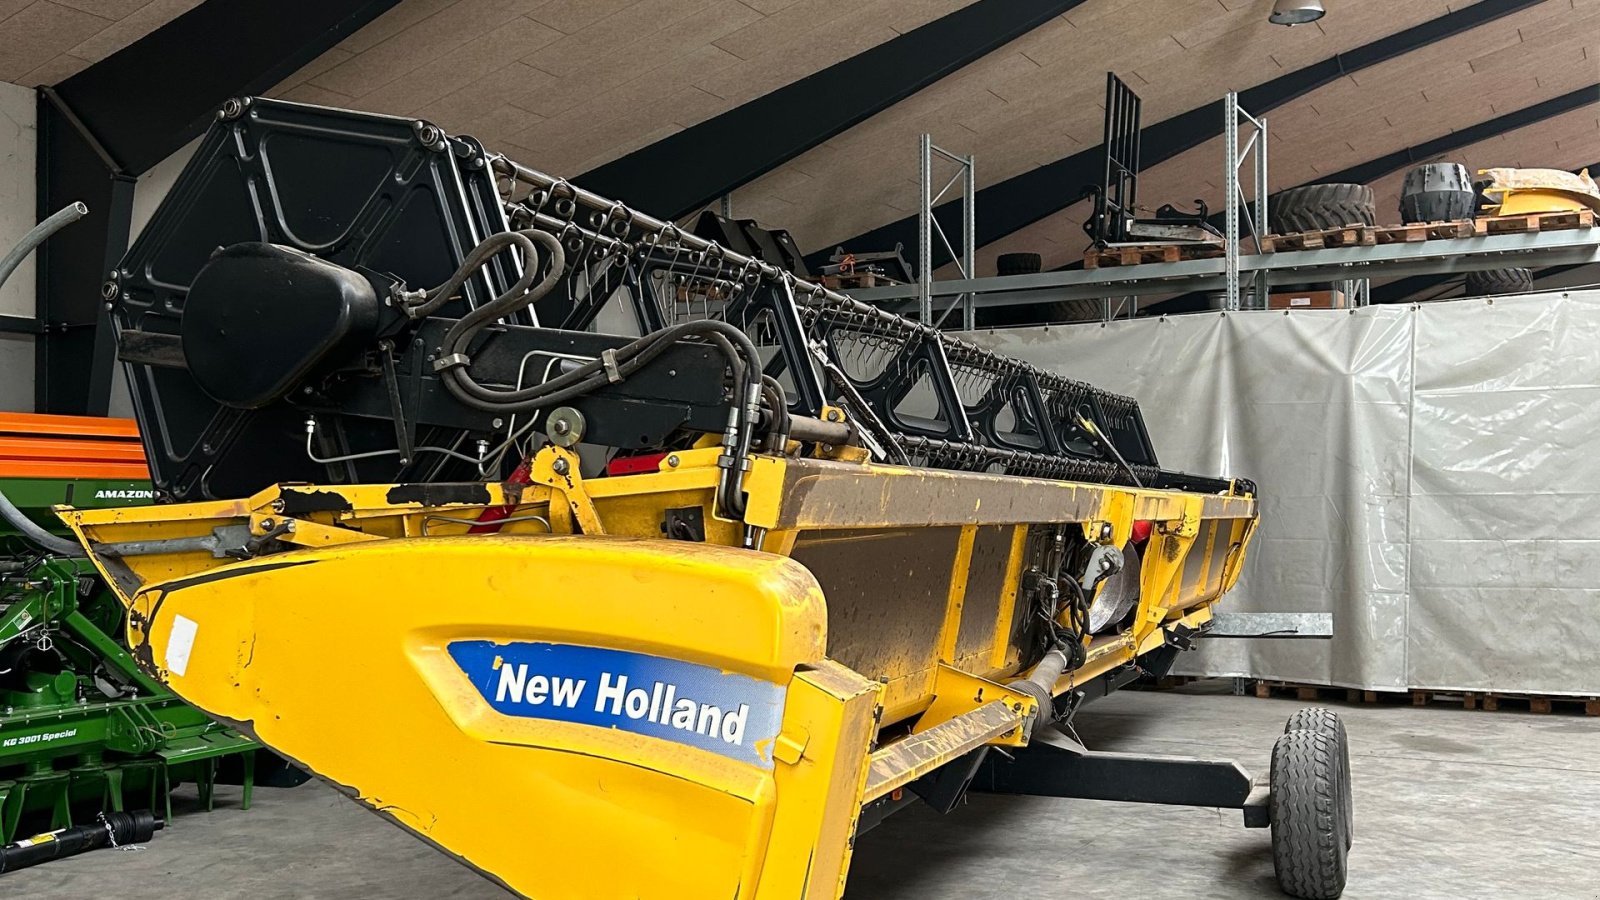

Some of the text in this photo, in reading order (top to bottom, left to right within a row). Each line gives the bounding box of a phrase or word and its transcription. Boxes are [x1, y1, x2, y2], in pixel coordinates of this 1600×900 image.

[495, 663, 749, 745] New Holland
[3, 729, 77, 747] KG 3001 Special
